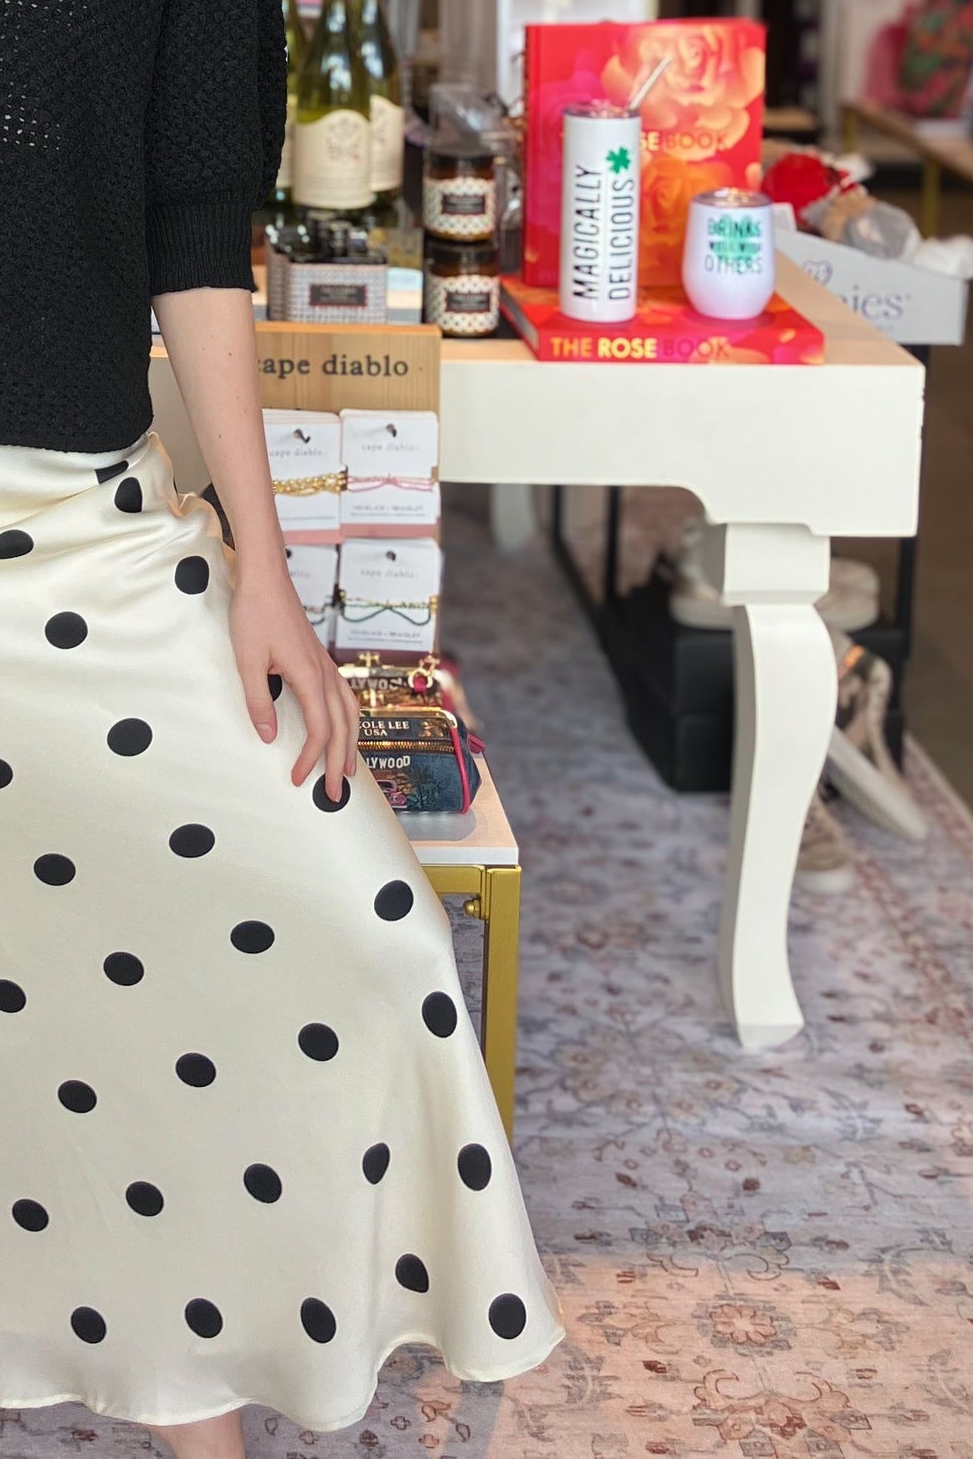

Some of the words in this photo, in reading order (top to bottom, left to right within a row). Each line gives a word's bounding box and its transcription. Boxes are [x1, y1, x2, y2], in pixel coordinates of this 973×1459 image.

[665, 131, 729, 150] BOOK
[573, 164, 602, 300] MAGICALLY
[609, 178, 634, 300] DELICIOUS
[704, 254, 762, 274] OTHERS
[550, 337, 593, 358] THE
[597, 337, 658, 359] ROSE
[663, 338, 729, 358] BOOK
[322, 354, 409, 377] diablo
[363, 729, 388, 737] USA
[388, 721, 410, 730] LEE
